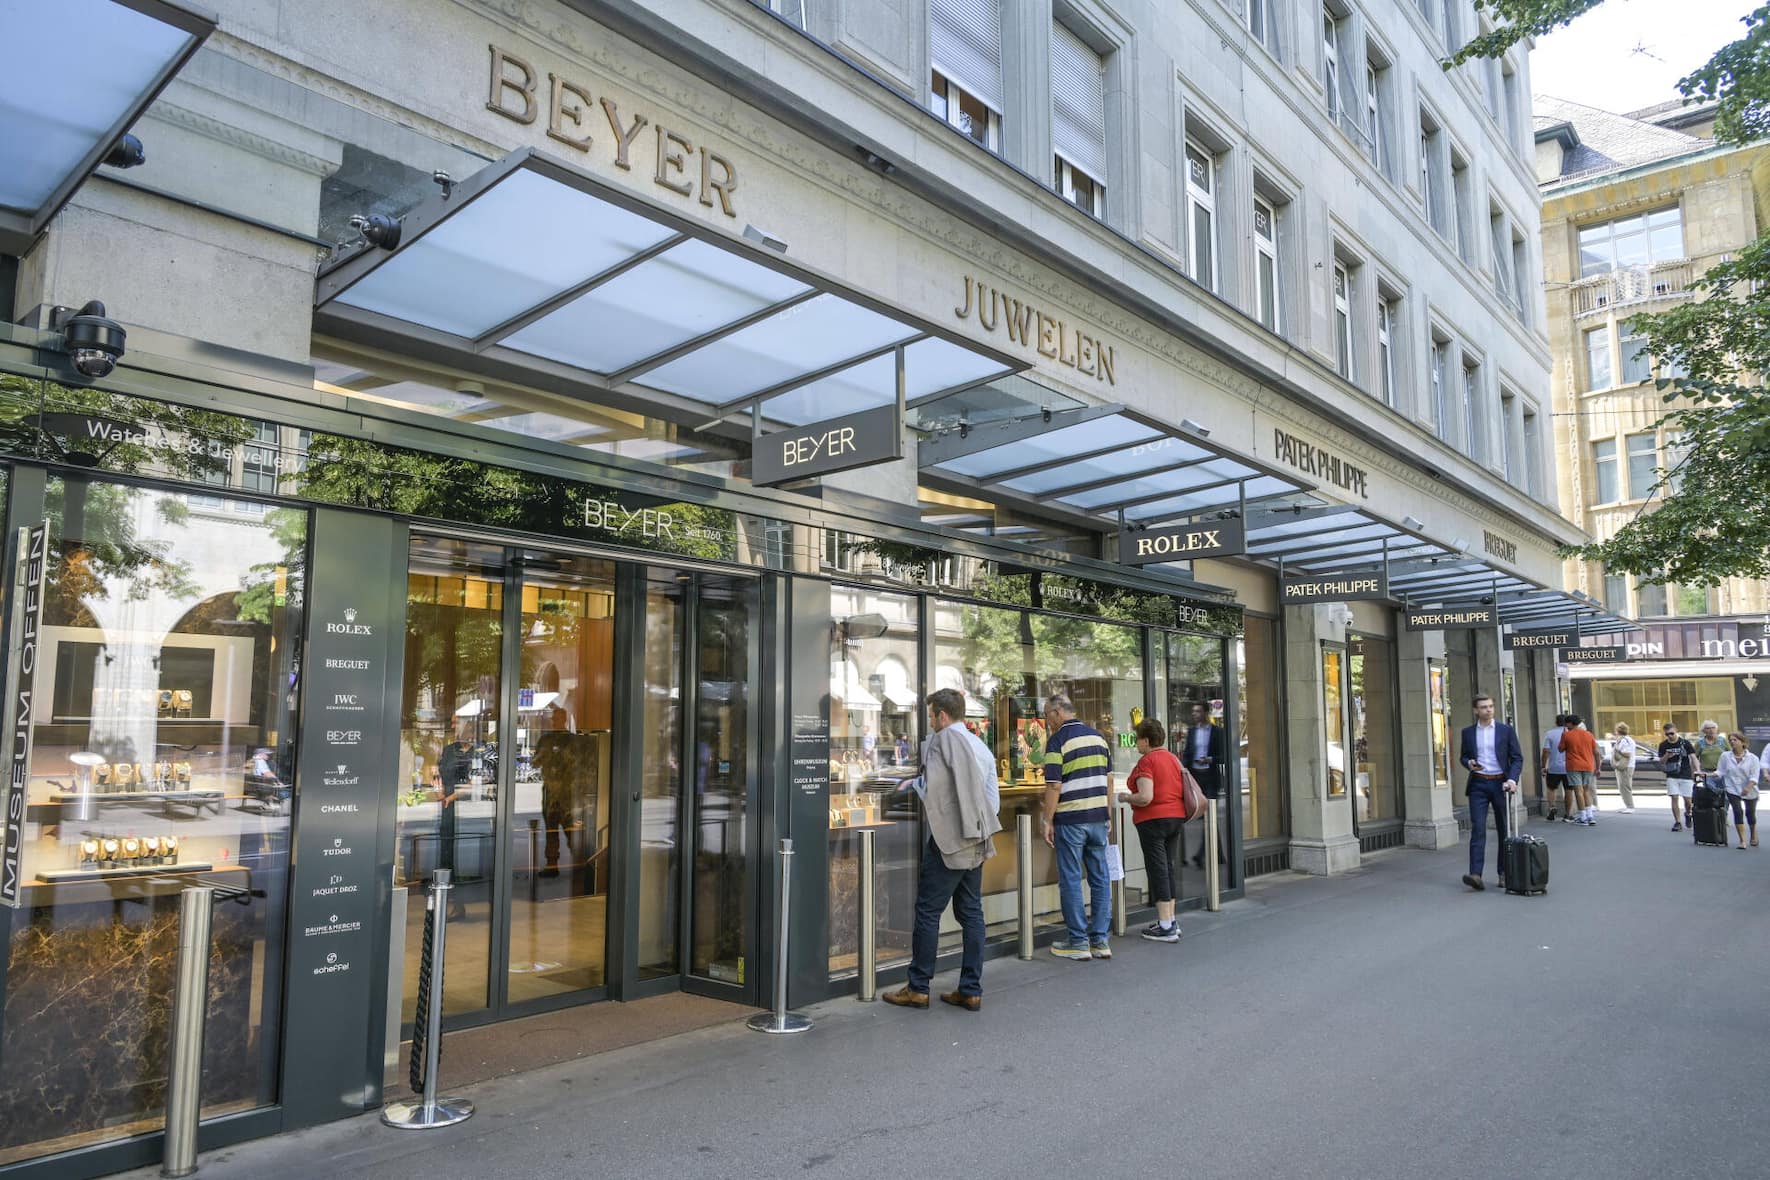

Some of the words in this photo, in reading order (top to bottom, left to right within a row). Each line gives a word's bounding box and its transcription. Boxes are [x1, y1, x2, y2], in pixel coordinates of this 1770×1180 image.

[487, 44, 737, 217] BEYER
[955, 275, 1115, 385] JUWELEN
[86, 420, 181, 452] Watches
[188, 438, 205, 455] &
[210, 441, 304, 472] Jewellery
[783, 427, 856, 466] BEYER
[1275, 428, 1316, 475] PATEK
[1318, 449, 1368, 499] PHILIPPE
[585, 499, 673, 540] BEYER
[1137, 530, 1221, 556] ROLEX
[1286, 583, 1321, 597] PATEK
[1324, 579, 1378, 595] PHILIPPE
[1180, 605, 1209, 626] BEYER
[1411, 614, 1442, 625] PATEK
[1443, 611, 1489, 624] PHILIPPE
[326, 623, 372, 635] ROLEX
[1513, 634, 1568, 647] BREGUET
[1567, 649, 1617, 660] BREGUET
[1627, 642, 1663, 656] DIN
[326, 659, 370, 669] BREGUET
[335, 694, 357, 705] IWC
[3, 691, 31, 896] MUSEUM
[22, 529, 44, 675] OFFEN
[327, 731, 361, 741] BEYER
[321, 804, 359, 813] CHANEL
[323, 847, 352, 856] TUDOR
[312, 887, 338, 896] JAQUET
[339, 885, 358, 893] DROZ
[305, 925, 327, 934] BAUME
[333, 921, 361, 930] MERCIER
